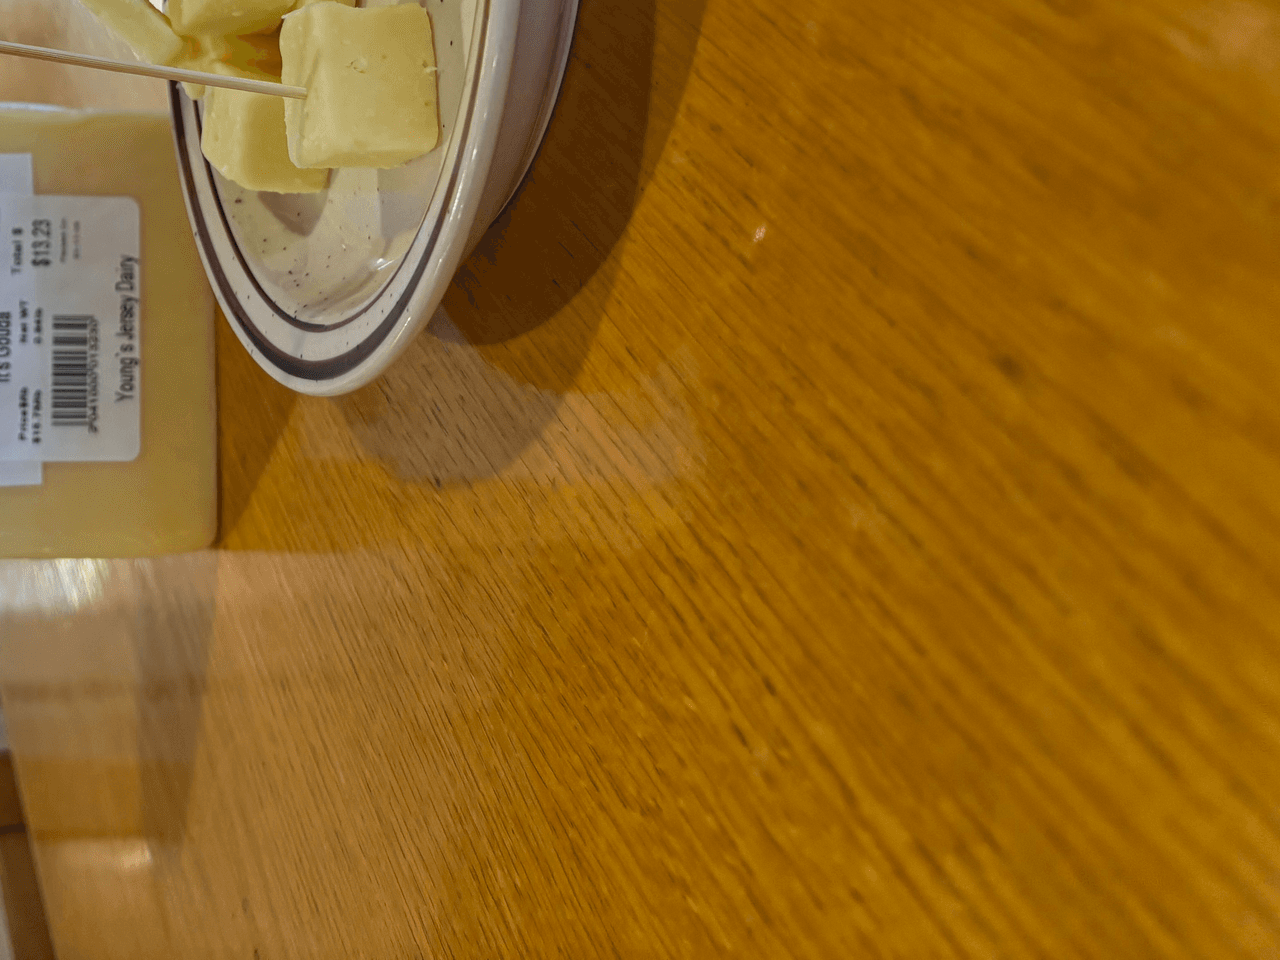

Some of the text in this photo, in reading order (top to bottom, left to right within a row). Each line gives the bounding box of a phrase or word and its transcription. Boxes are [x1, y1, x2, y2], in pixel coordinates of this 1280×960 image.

[10, 240, 23, 277] Total
[30, 219, 52, 267] $13.23
[114, 254, 141, 292] Dairy
[114, 295, 141, 340] Jersey
